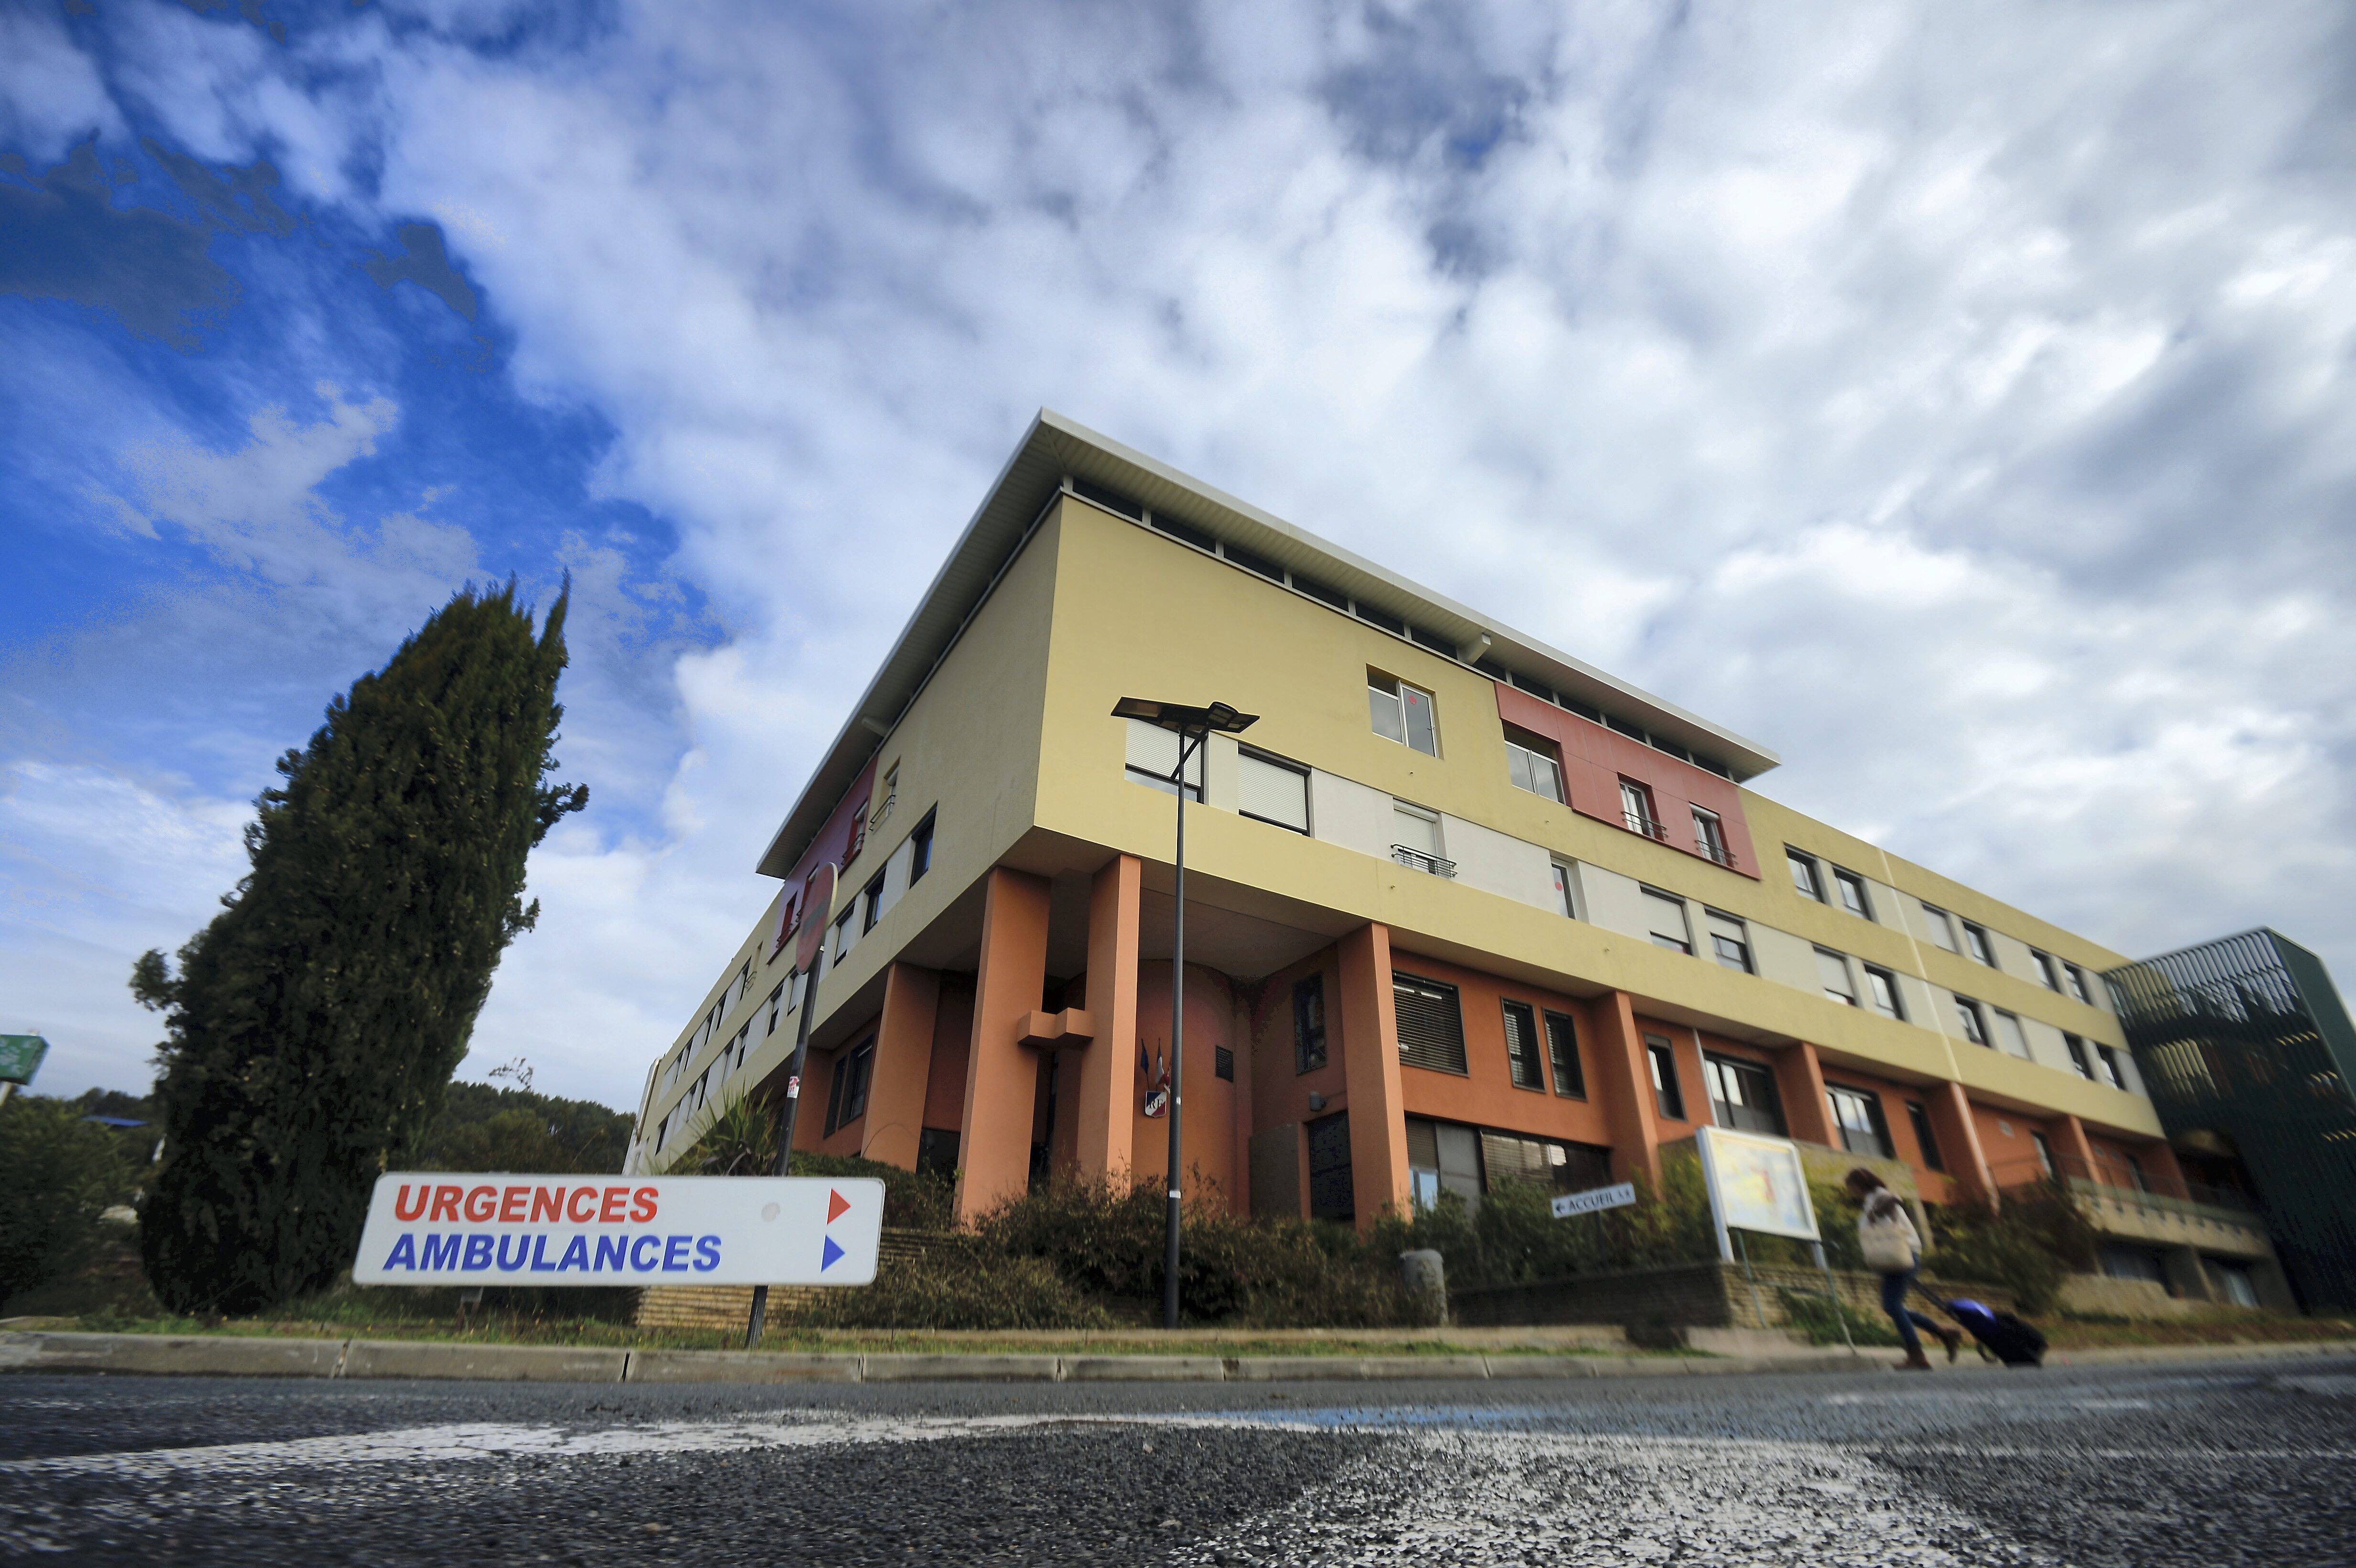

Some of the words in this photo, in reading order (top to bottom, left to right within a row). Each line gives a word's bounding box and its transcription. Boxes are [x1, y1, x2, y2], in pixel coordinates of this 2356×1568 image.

[395, 1185, 659, 1223] URGENCES
[1569, 1192, 1614, 1210] ACCUEIL
[383, 1233, 722, 1273] AMBULANCES
